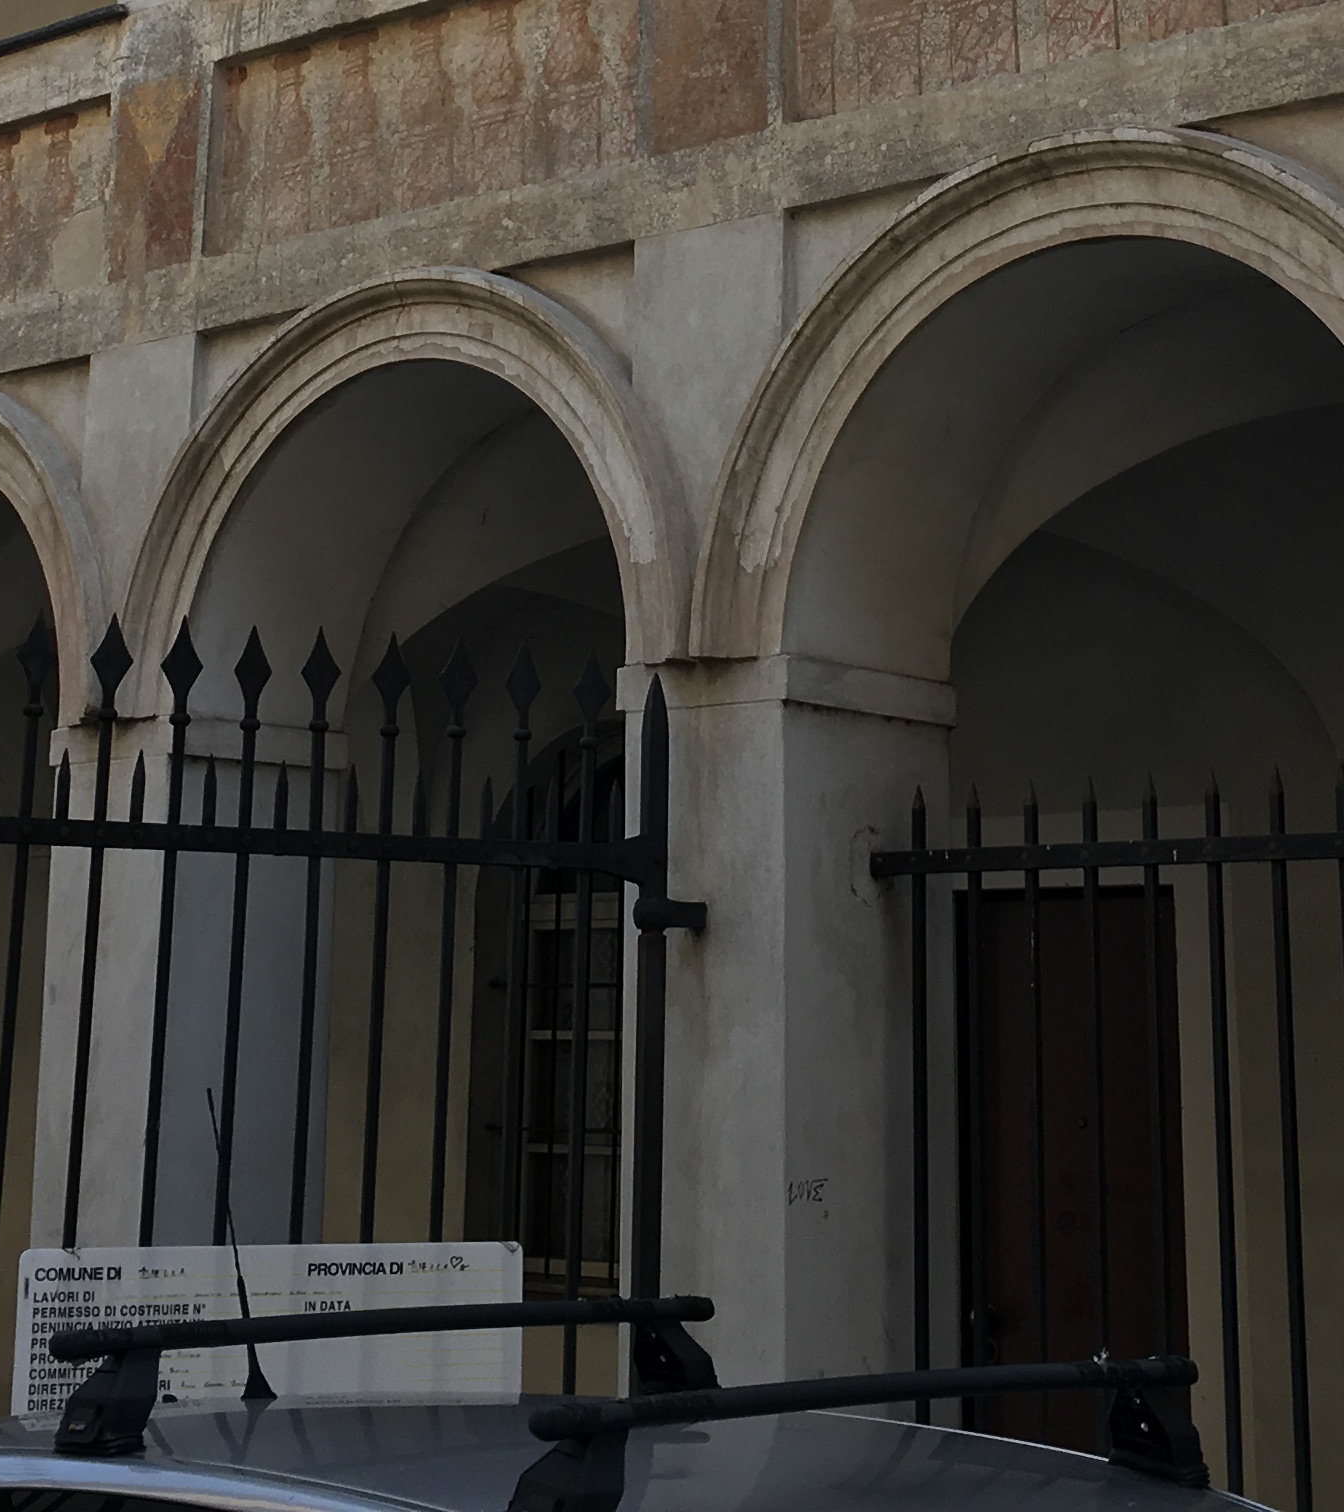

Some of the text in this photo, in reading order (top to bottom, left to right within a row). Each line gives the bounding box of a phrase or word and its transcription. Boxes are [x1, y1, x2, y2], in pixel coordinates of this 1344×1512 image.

[34, 1267, 104, 1281] COMUNE
[107, 1266, 122, 1281] DI
[307, 1261, 387, 1276] PROVINCIA
[389, 1261, 404, 1275] DI
[33, 1291, 95, 1303] LAVORI DI
[32, 1306, 101, 1318] PERMESSO
[104, 1306, 116, 1317] DI
[119, 1304, 189, 1316] COSTRUIRE
[305, 1300, 351, 1312] IN DATA
[31, 1321, 94, 1334] DENUNCIA
